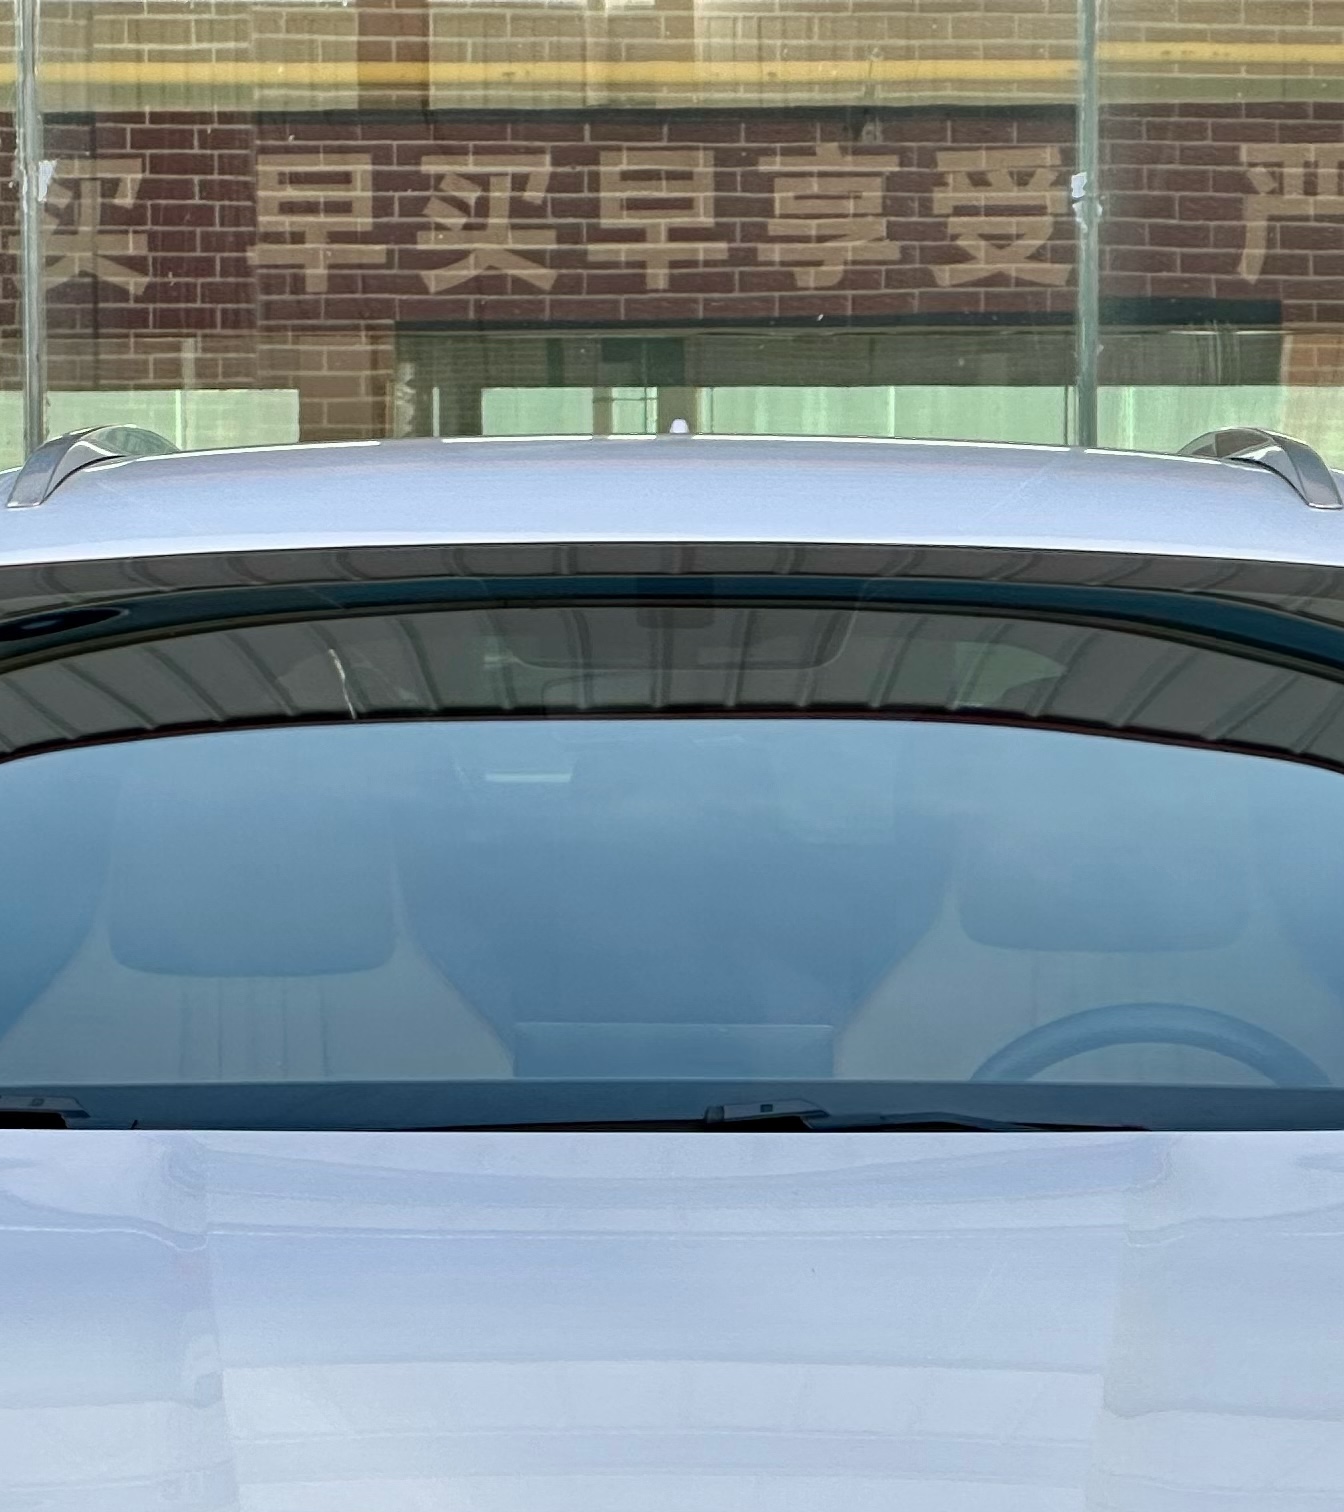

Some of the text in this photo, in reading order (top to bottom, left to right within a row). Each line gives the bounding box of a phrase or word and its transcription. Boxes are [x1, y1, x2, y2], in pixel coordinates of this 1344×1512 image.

[246, 141, 1075, 292] 早买早享受
